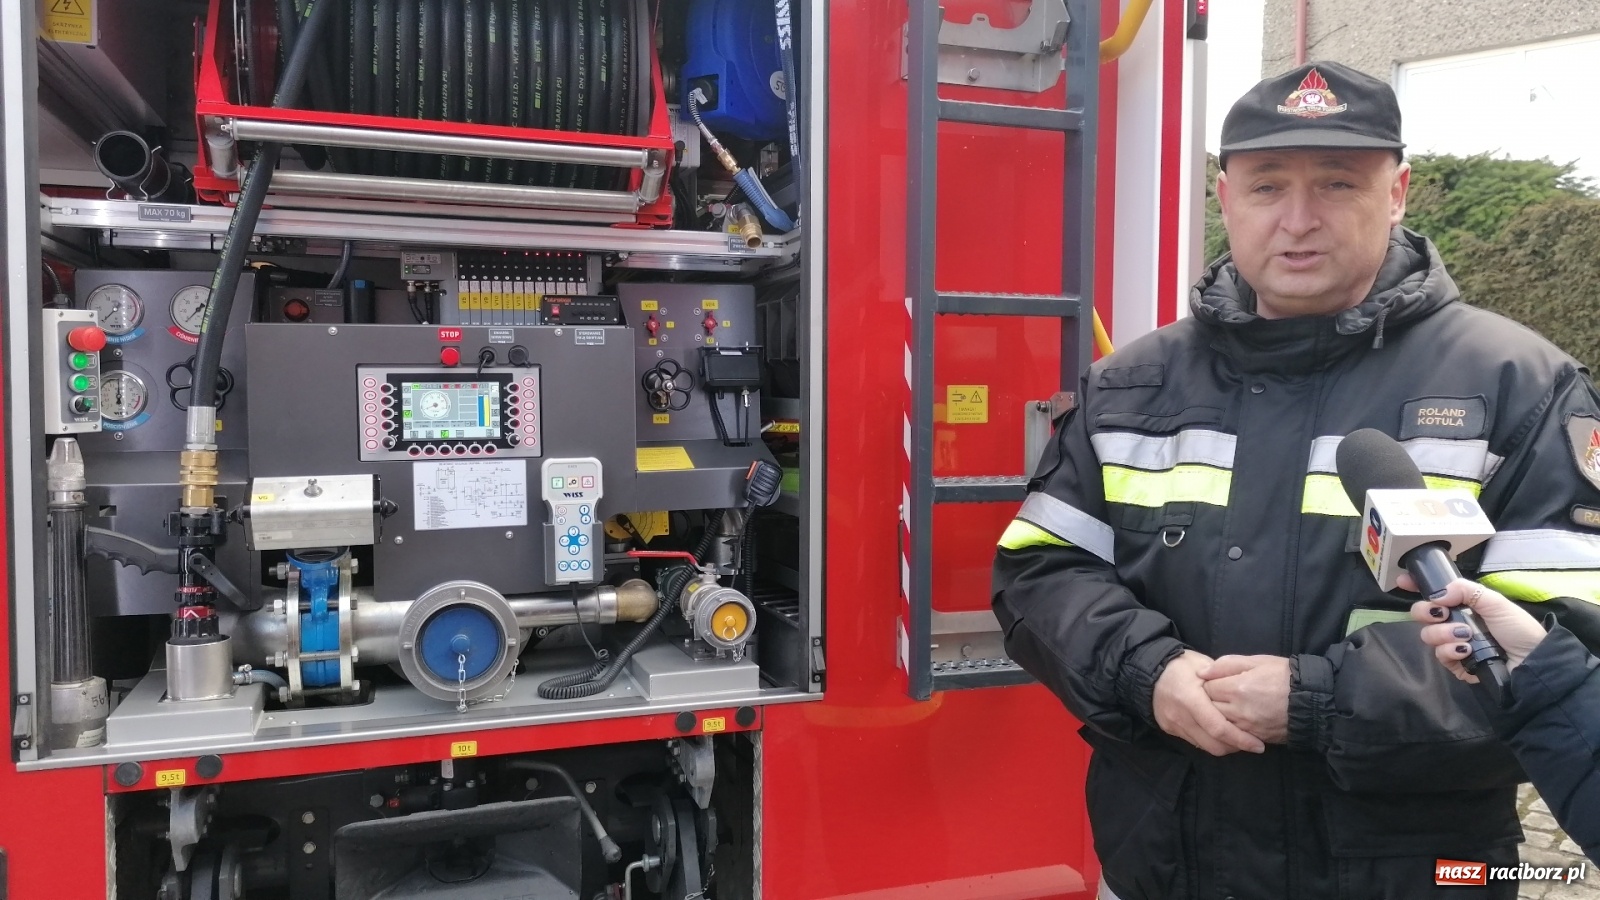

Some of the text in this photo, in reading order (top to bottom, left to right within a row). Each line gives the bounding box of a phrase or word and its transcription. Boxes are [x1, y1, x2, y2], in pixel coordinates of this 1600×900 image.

[467, 45, 473, 57] DN
[578, 66, 584, 76] 25
[578, 77, 584, 90] DN
[512, 96, 518, 105] 25
[512, 106, 518, 118] DN
[236, 200, 244, 212] DN
[144, 208, 186, 219] MAX 70 kg
[1418, 407, 1466, 417] ROLAND
[1417, 417, 1464, 427] KOTULA
